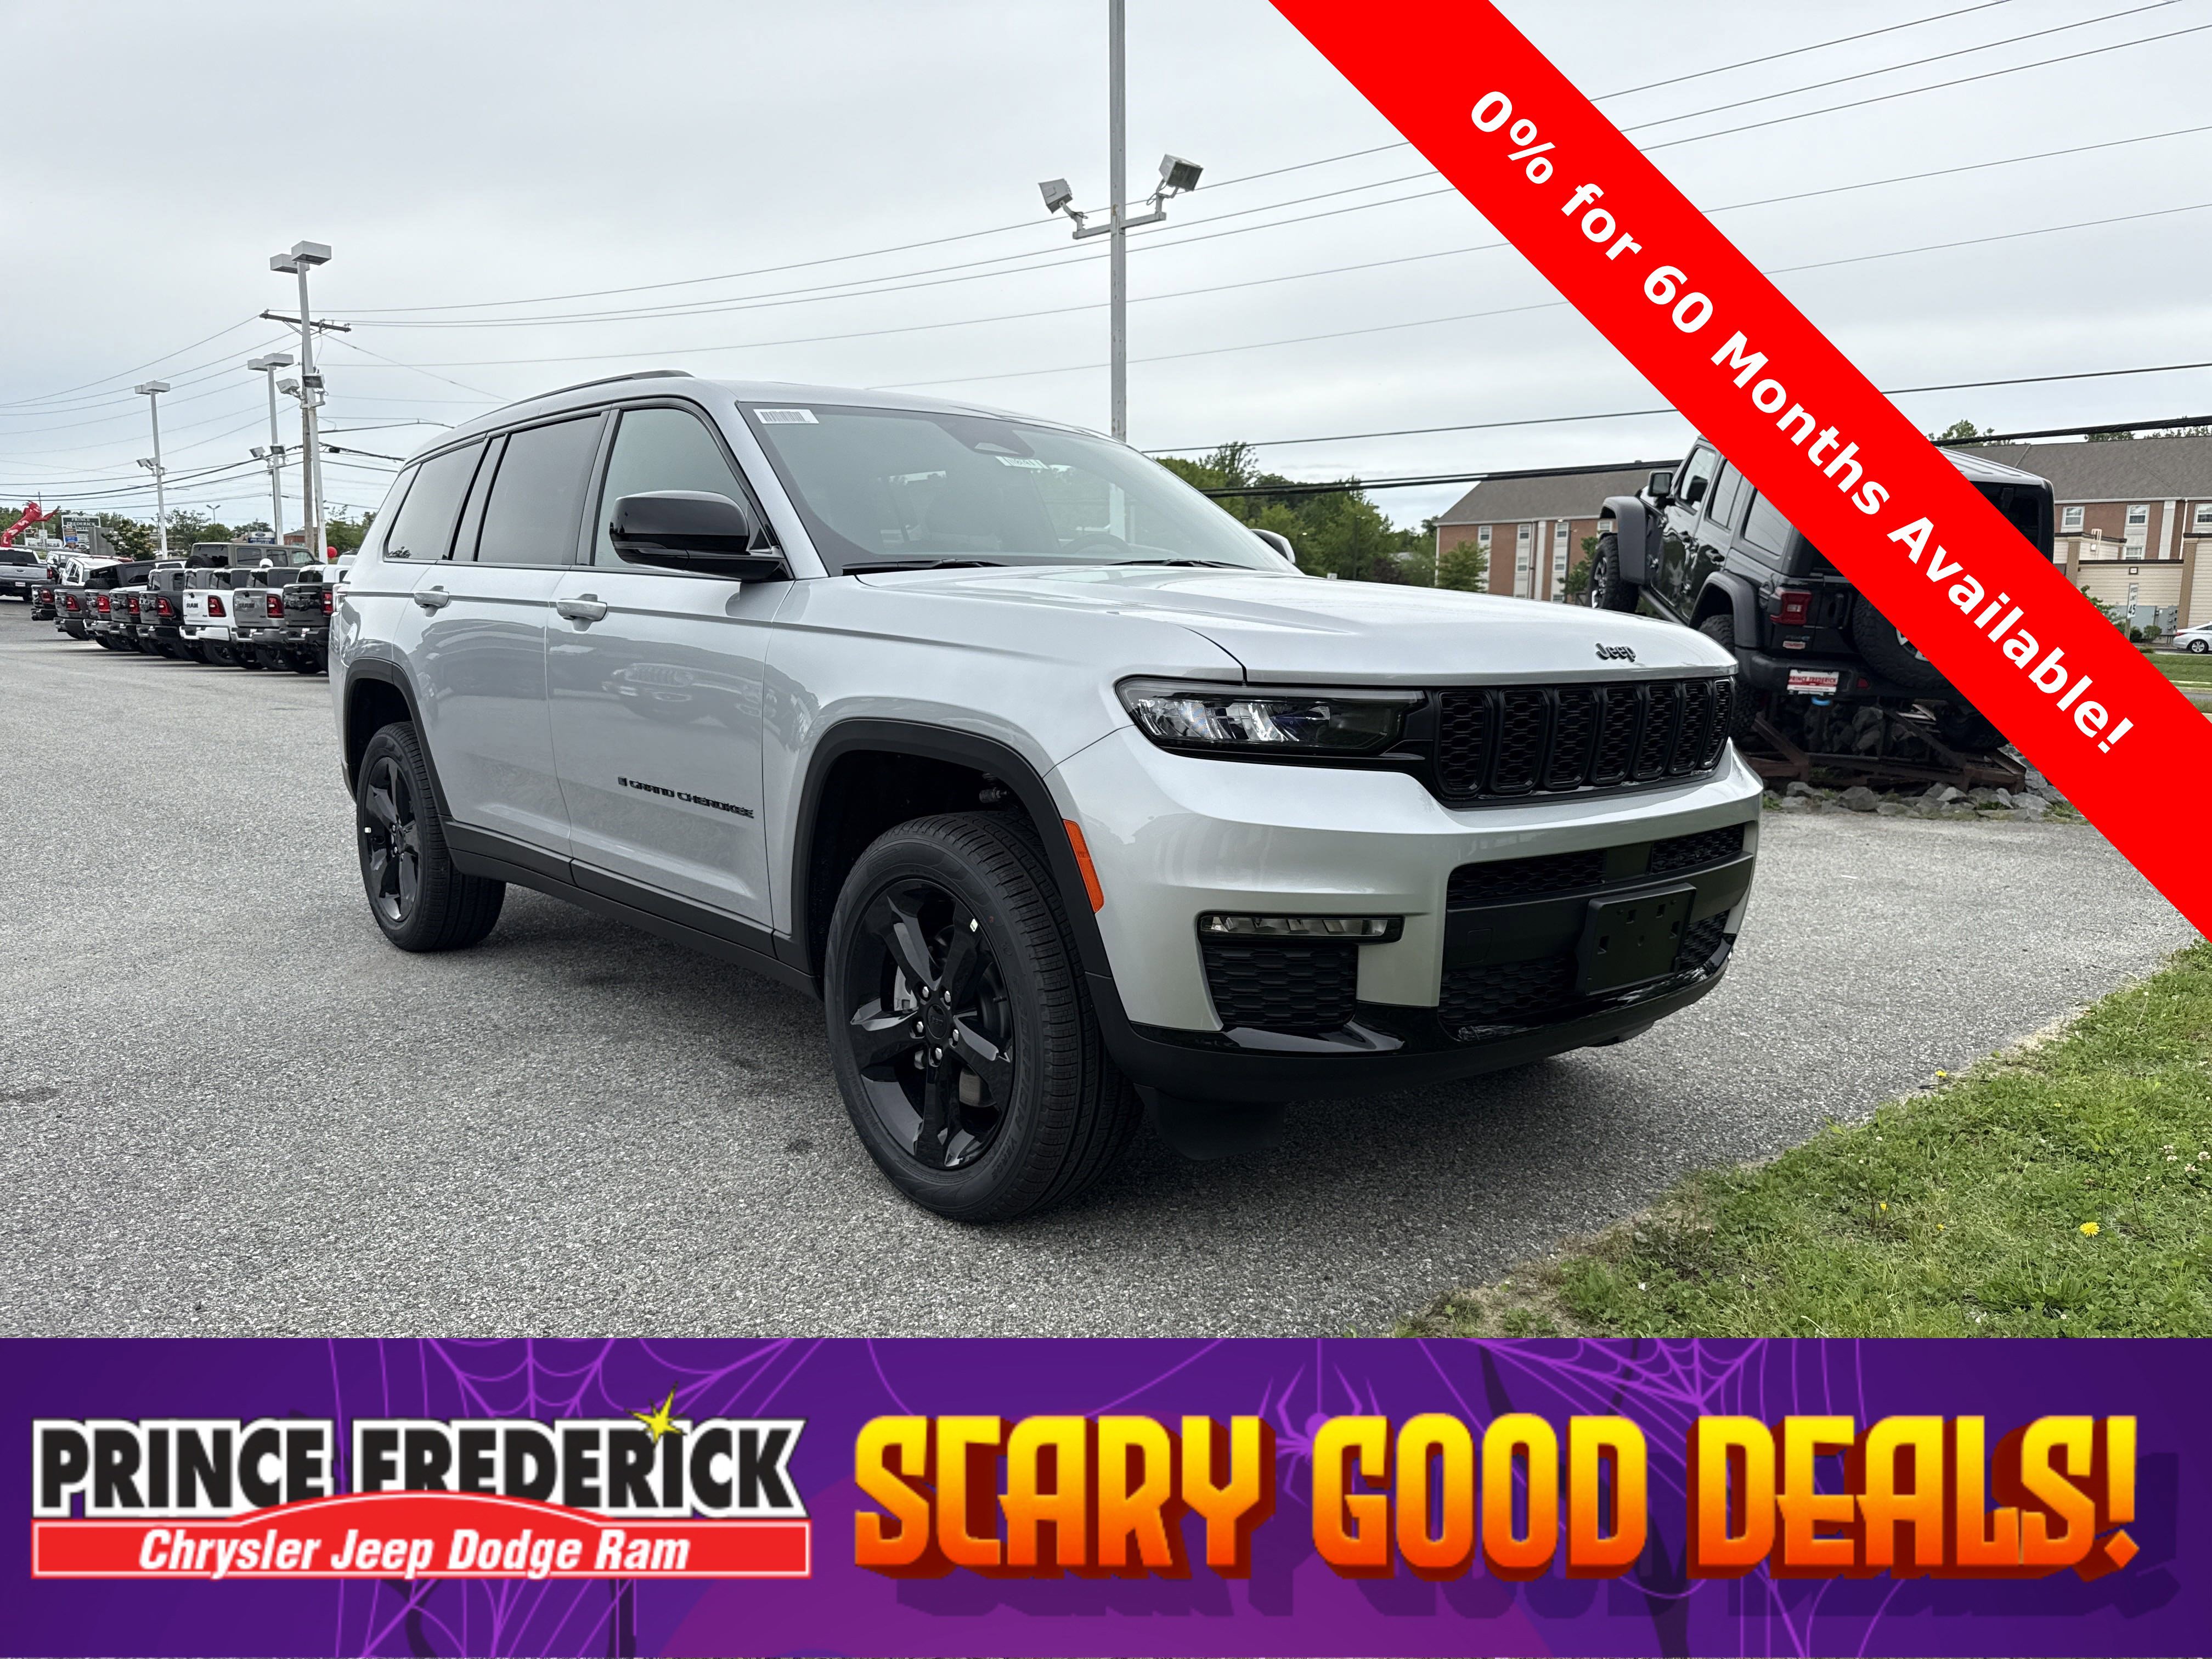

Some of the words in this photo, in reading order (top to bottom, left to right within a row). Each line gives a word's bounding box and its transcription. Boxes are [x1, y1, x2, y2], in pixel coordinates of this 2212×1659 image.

[2128, 604, 2136, 615] 45
[1595, 643, 1636, 663] Jeep
[629, 780, 675, 798] GRAND
[677, 792, 755, 819] CHEROKEE
